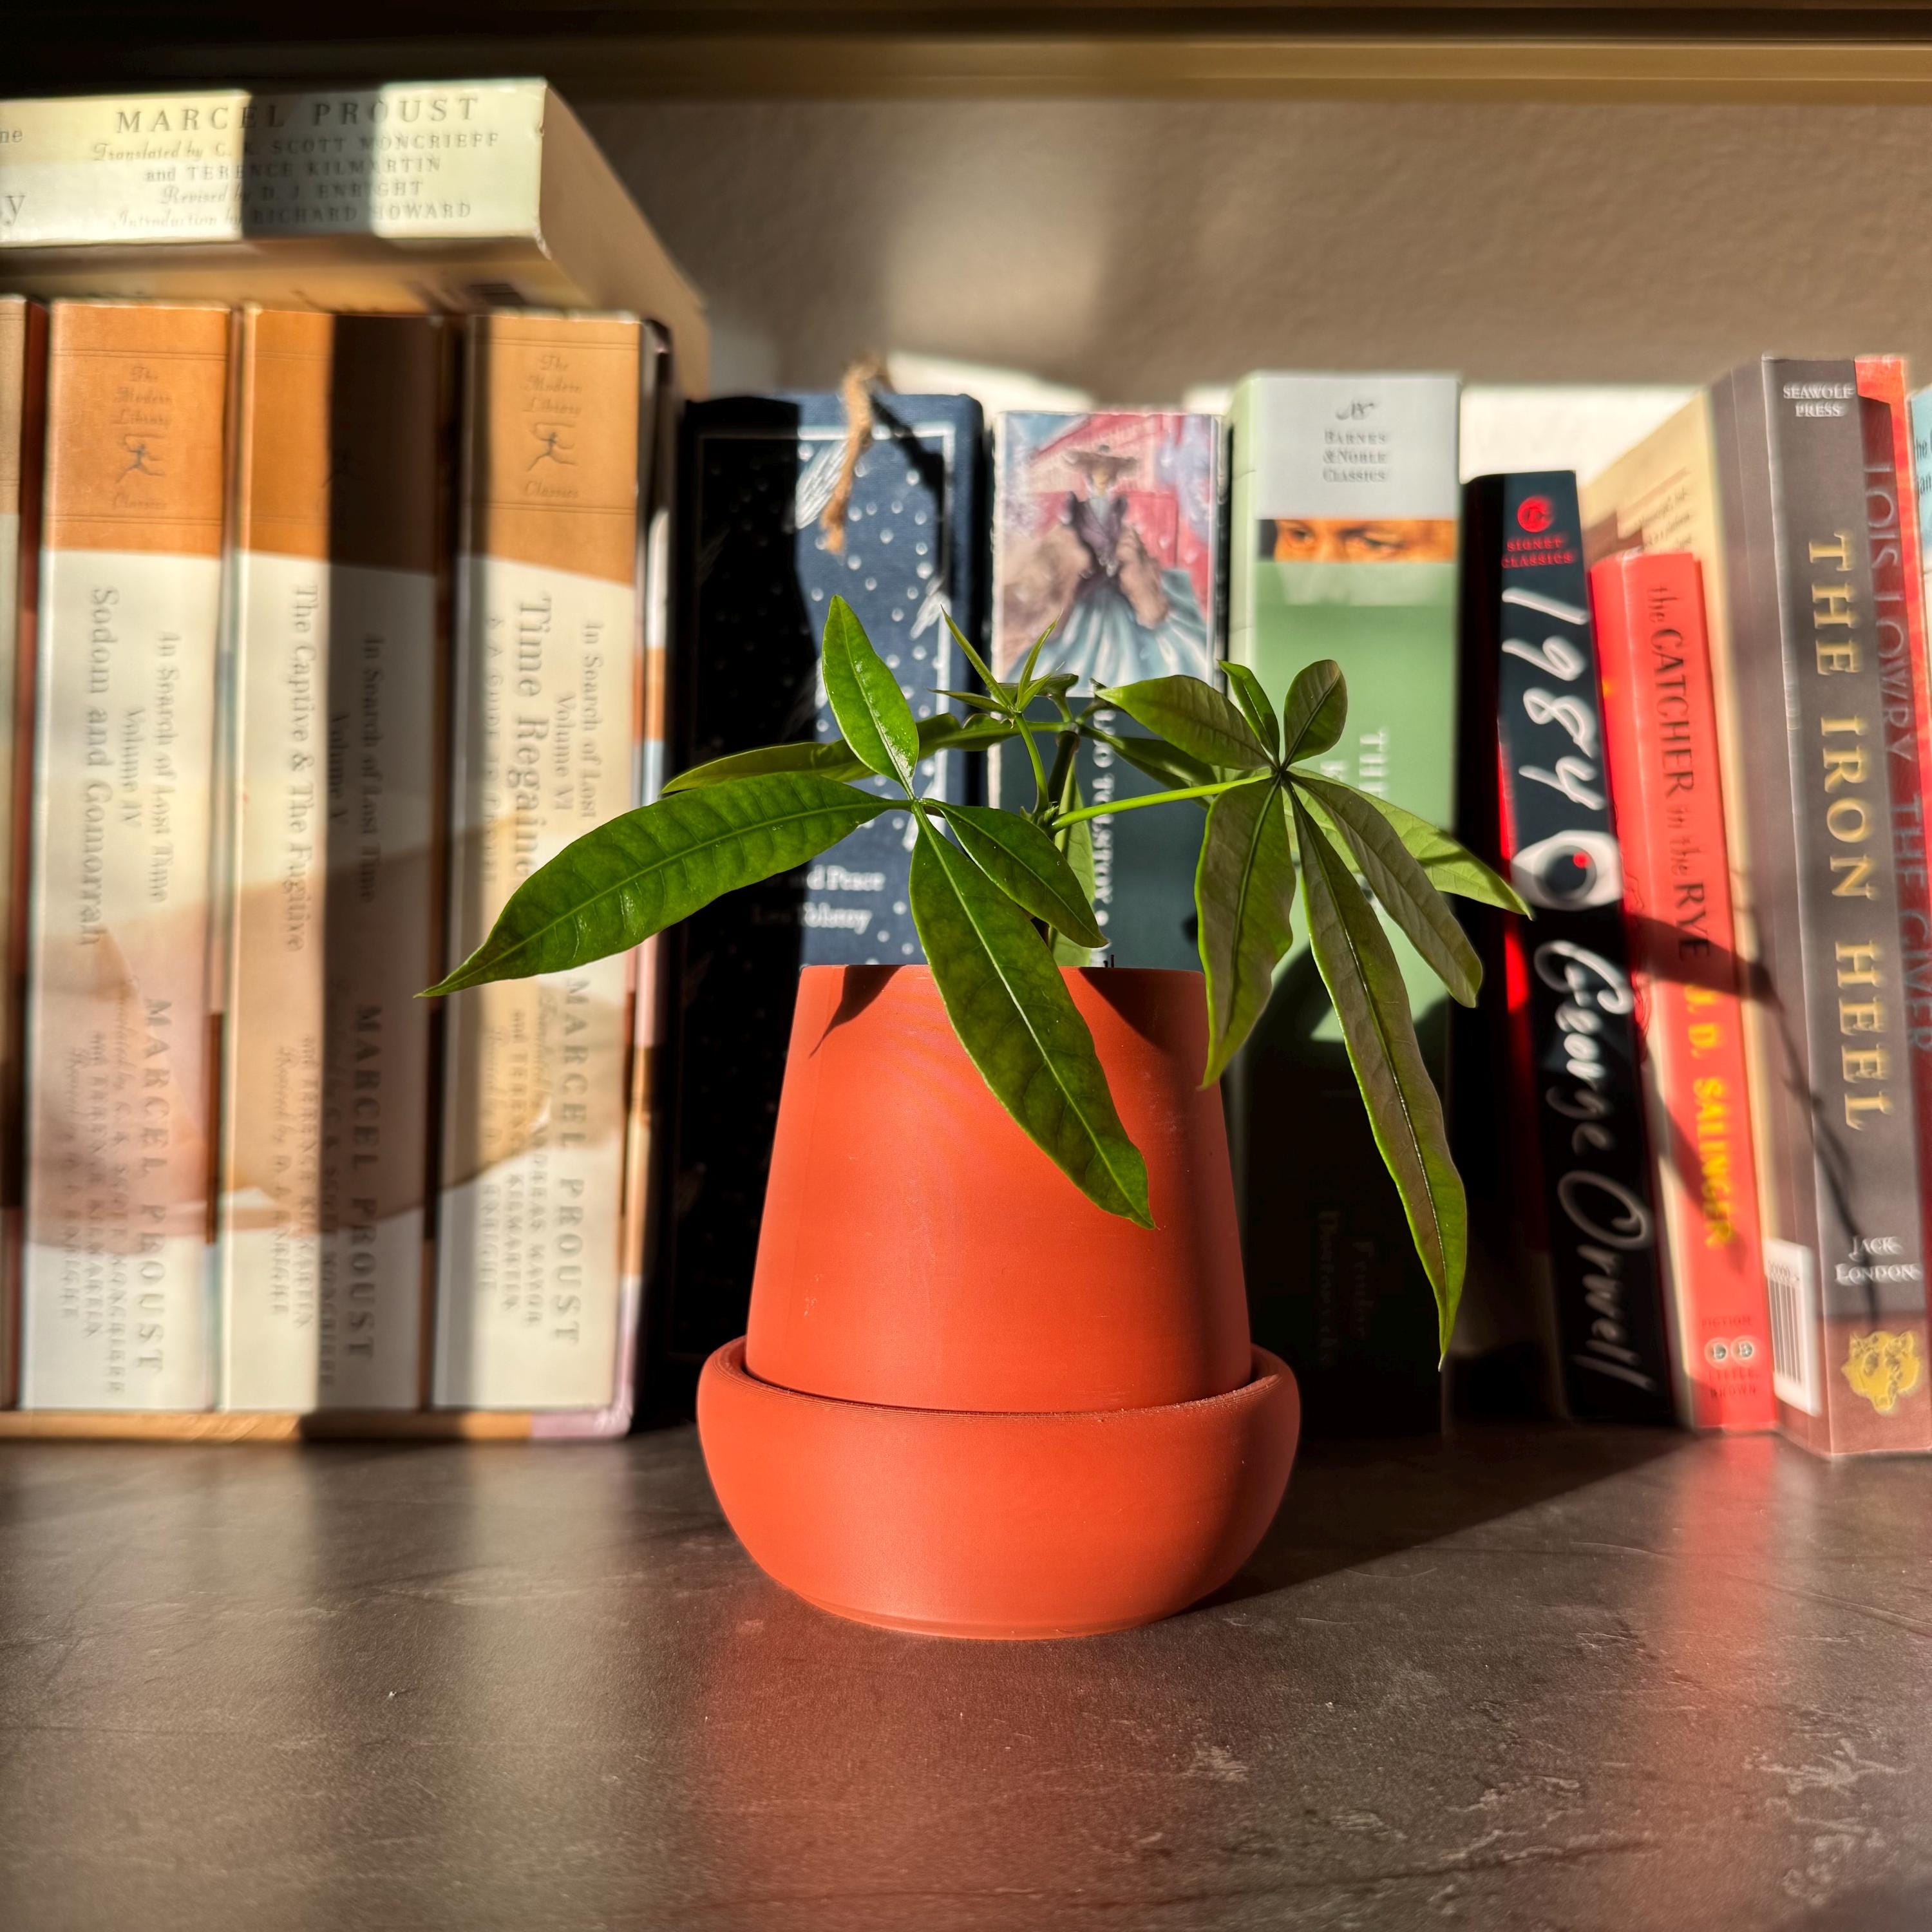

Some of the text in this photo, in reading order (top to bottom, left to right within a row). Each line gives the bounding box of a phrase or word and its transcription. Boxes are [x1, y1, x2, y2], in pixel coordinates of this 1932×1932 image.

[116, 97, 478, 134] MARCEL PROUST
[93, 140, 181, 161] Translated
[187, 141, 204, 158] by
[270, 137, 348, 155] SCOTT
[359, 131, 500, 152] MONCRIEFF
[145, 156, 442, 182] and TERENCE KILMARTIN
[159, 184, 226, 205] Revised
[318, 180, 423, 200] ENRIGHT
[252, 205, 358, 225] RICHARD
[369, 202, 472, 220] HOWARD
[1783, 383, 1855, 399] SEAWOLF
[1794, 402, 1843, 417] PRESS
[1324, 428, 1387, 446] BARNES
[1338, 448, 1388, 464] NOBLE
[1322, 466, 1388, 483] CLASSICS
[1501, 547, 1577, 569] CLASSICS
[1506, 535, 1565, 553] SIGNET
[1647, 585, 1680, 624] the
[578, 619, 603, 819] In Search of Lost
[1501, 587, 1607, 811] 1984
[1649, 627, 1696, 799] CATCHER
[77, 585, 118, 947] Sodom and Gomorrah
[118, 706, 144, 828] Volume IV
[149, 630, 180, 903] In Search of Lost Time
[282, 583, 317, 953] The Captive & The Fugitive
[328, 710, 349, 826] Volume V
[359, 633, 382, 903] In Search of Lost Time
[507, 595, 550, 881] Time Regaine
[552, 691, 574, 811] Volume VI
[1666, 806, 1685, 829] in
[1808, 530, 1895, 1132] THE IRON HEEL
[827, 865, 887, 892] Peace
[1668, 838, 1703, 876] the
[1672, 882, 1711, 963] RYE
[1684, 987, 1736, 1247] J. D. SALINGER
[133, 999, 170, 1376] MARCEL PROUST
[346, 1003, 380, 1363] MARCEL PROUST
[554, 979, 589, 1345] MARCEL PROUST
[1533, 940, 1656, 1391] George Orwell
[1834, 1262, 1924, 1287] LONDON
[1848, 1236, 1904, 1262] JACK
